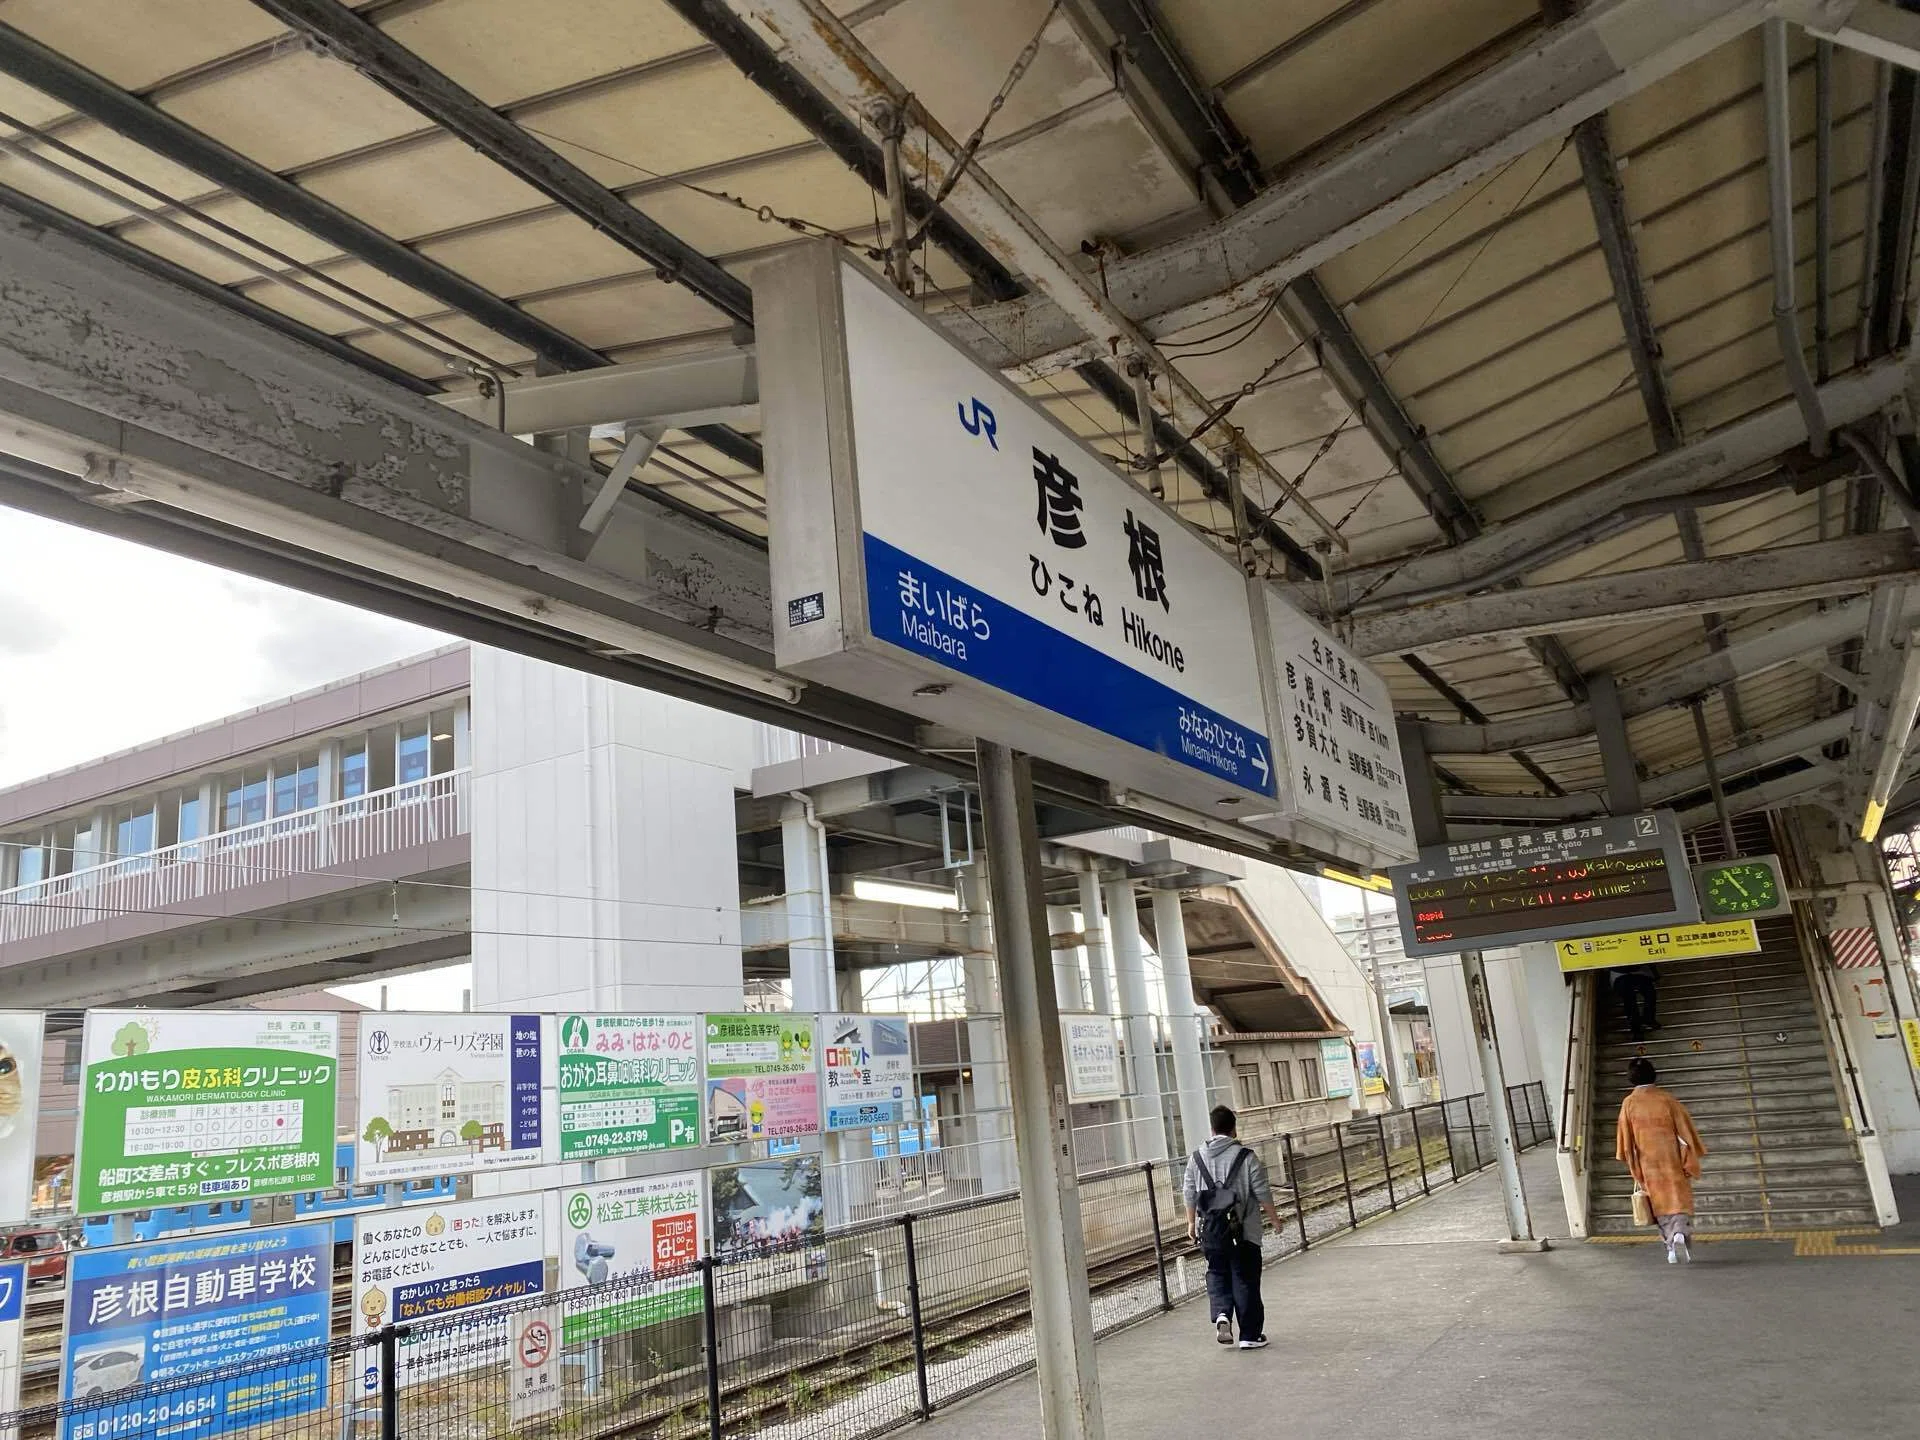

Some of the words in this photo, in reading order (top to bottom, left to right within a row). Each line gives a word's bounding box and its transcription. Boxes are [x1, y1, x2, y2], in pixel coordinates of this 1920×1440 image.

[958, 396, 999, 451] JR
[1032, 445, 1170, 614] 彦根
[1029, 554, 1103, 626] ひこね
[898, 571, 990, 640] まいばら
[901, 610, 967, 661] Maibara
[1121, 606, 1184, 673] Hikone
[1312, 636, 1360, 692] 名所案内
[1179, 706, 1246, 758] みなみひこね
[1293, 713, 1341, 764] 多賀大社
[1640, 818, 1653, 834] 2
[1518, 845, 1554, 856] Kusatsu,
[1639, 932, 1670, 946] 出口
[1648, 947, 1666, 955] Exit
[419, 1031, 504, 1053] ヴォーリズ学園
[514, 1030, 537, 1041] 地の塩
[596, 1031, 693, 1052] みみ・はな・のど
[826, 1046, 870, 1067] ロボット
[95, 1065, 331, 1093] わかもり皮ふ科クリニック
[560, 1057, 697, 1089] おがわ耳鼻咽喉科クリニック
[146, 1093, 194, 1104] WAKAMORI
[196, 1090, 259, 1101] DERMATOLOGY
[260, 1089, 287, 1098] CLINIC
[860, 1112, 889, 1123] PRO-SEED
[596, 1189, 699, 1224] 松金工業株式会社
[362, 1225, 421, 1245] 働くあなたの
[656, 1219, 693, 1239] この世は
[362, 1239, 468, 1265] どんなに小さなことでも、
[361, 1260, 436, 1283] お電話ください。
[88, 1254, 316, 1326] 彦根自動車学校
[399, 1281, 526, 1318] 「なんでも労働相談ダイヤル」
[516, 1391, 527, 1400] No
[527, 1383, 556, 1398] Smoking
[524, 1373, 548, 1388] 禁煙
[98, 1395, 217, 1436] 0120-20-4654
